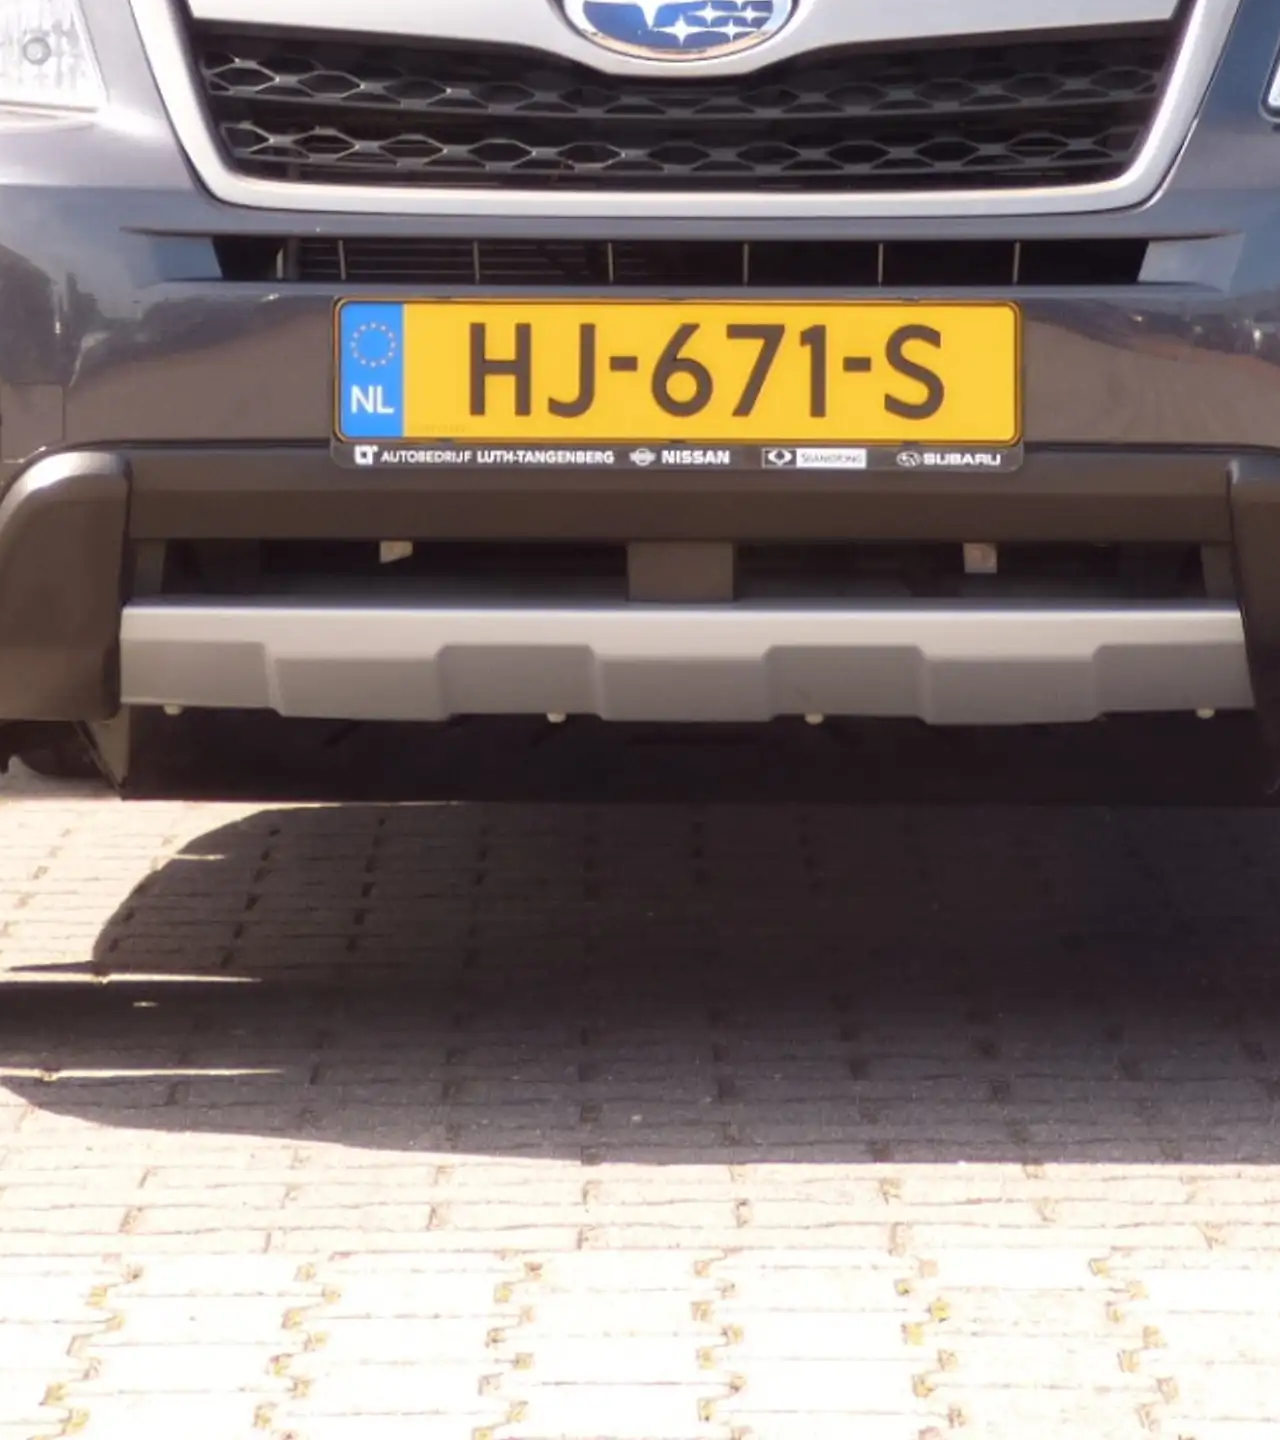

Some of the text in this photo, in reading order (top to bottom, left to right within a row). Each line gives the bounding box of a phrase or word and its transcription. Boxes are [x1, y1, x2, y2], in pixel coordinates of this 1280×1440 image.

[469, 322, 945, 420] HJ-671-S
[350, 385, 395, 414] NL
[380, 449, 615, 465] AUTOBEDRIJF LUTH-TANGENBERG
[661, 449, 731, 465] NISSAN
[922, 452, 1002, 467] SUBARU
